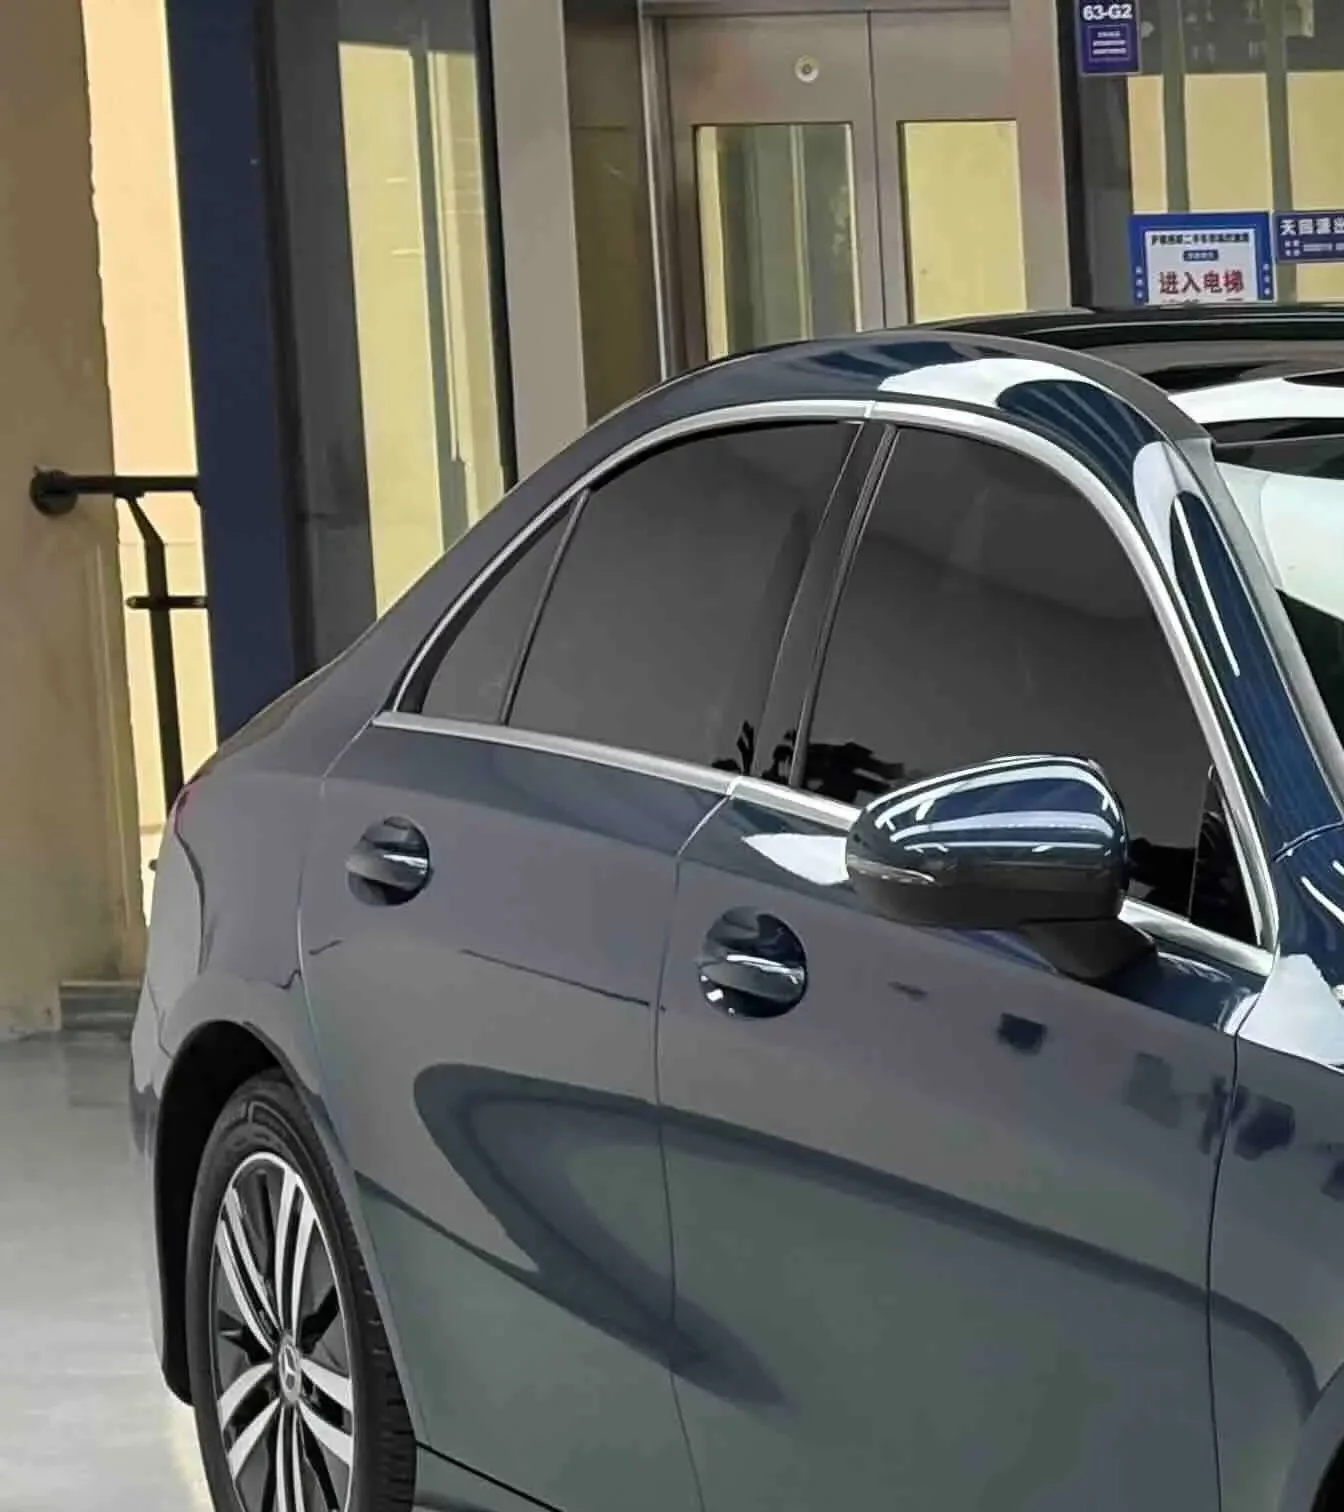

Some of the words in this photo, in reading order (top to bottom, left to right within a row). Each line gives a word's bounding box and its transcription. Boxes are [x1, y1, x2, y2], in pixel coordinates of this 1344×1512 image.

[1083, 4, 1133, 20] 63-G2
[1159, 270, 1244, 294] 进入电梯
